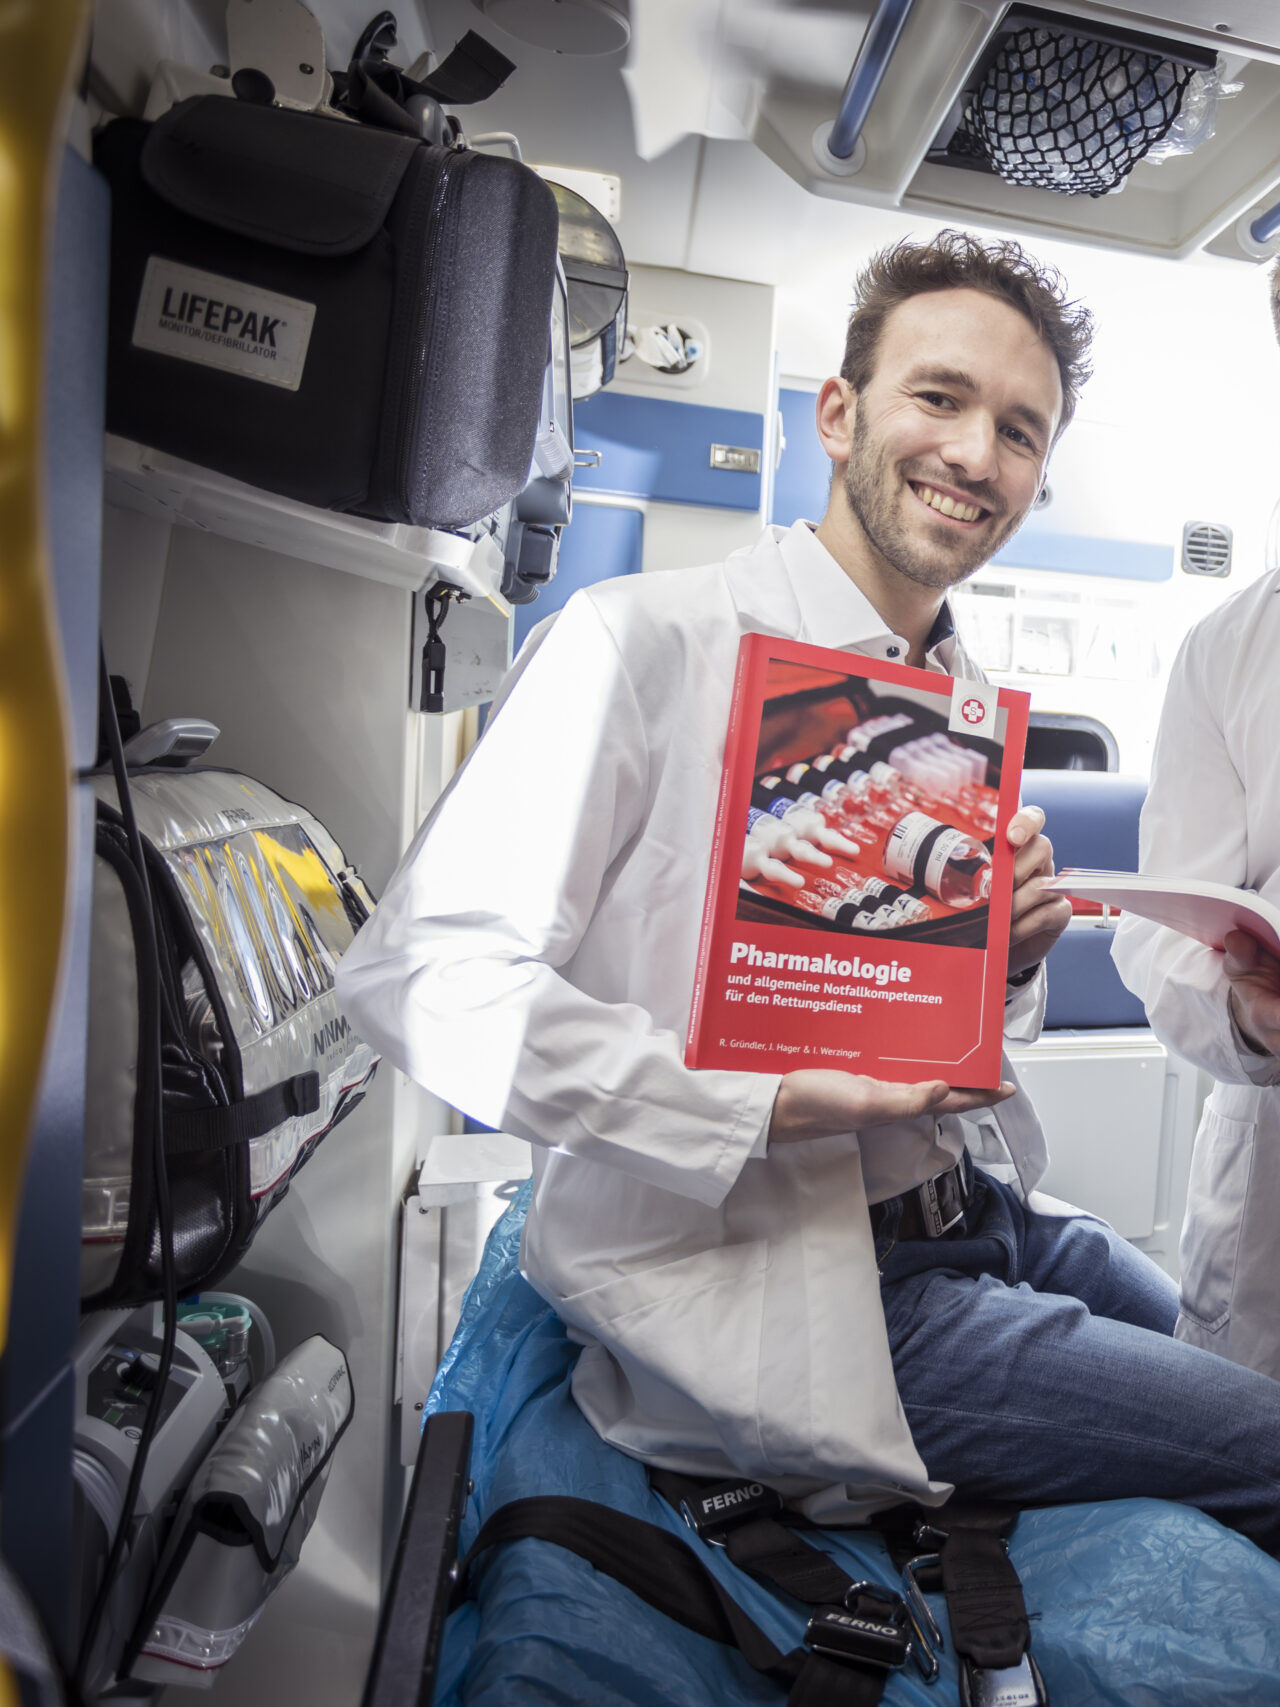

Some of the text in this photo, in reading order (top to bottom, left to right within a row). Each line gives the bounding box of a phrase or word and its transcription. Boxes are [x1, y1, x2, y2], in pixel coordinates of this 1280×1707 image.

[158, 318, 277, 361] MONITOR/DEFIBRILLATOR
[730, 942, 911, 986] Pharmakologie
[725, 989, 863, 1013] für den Rettungsdienst
[727, 974, 942, 1005] und allgemeine Notfallkompetenzen
[719, 1038, 728, 1047] R.
[730, 1039, 767, 1051] Gründler,
[777, 1043, 801, 1055] Hager
[803, 1045, 810, 1054] &
[820, 1047, 861, 1059] Werzinger
[702, 1483, 765, 1514] FERNO
[824, 1612, 899, 1637] FERNO
